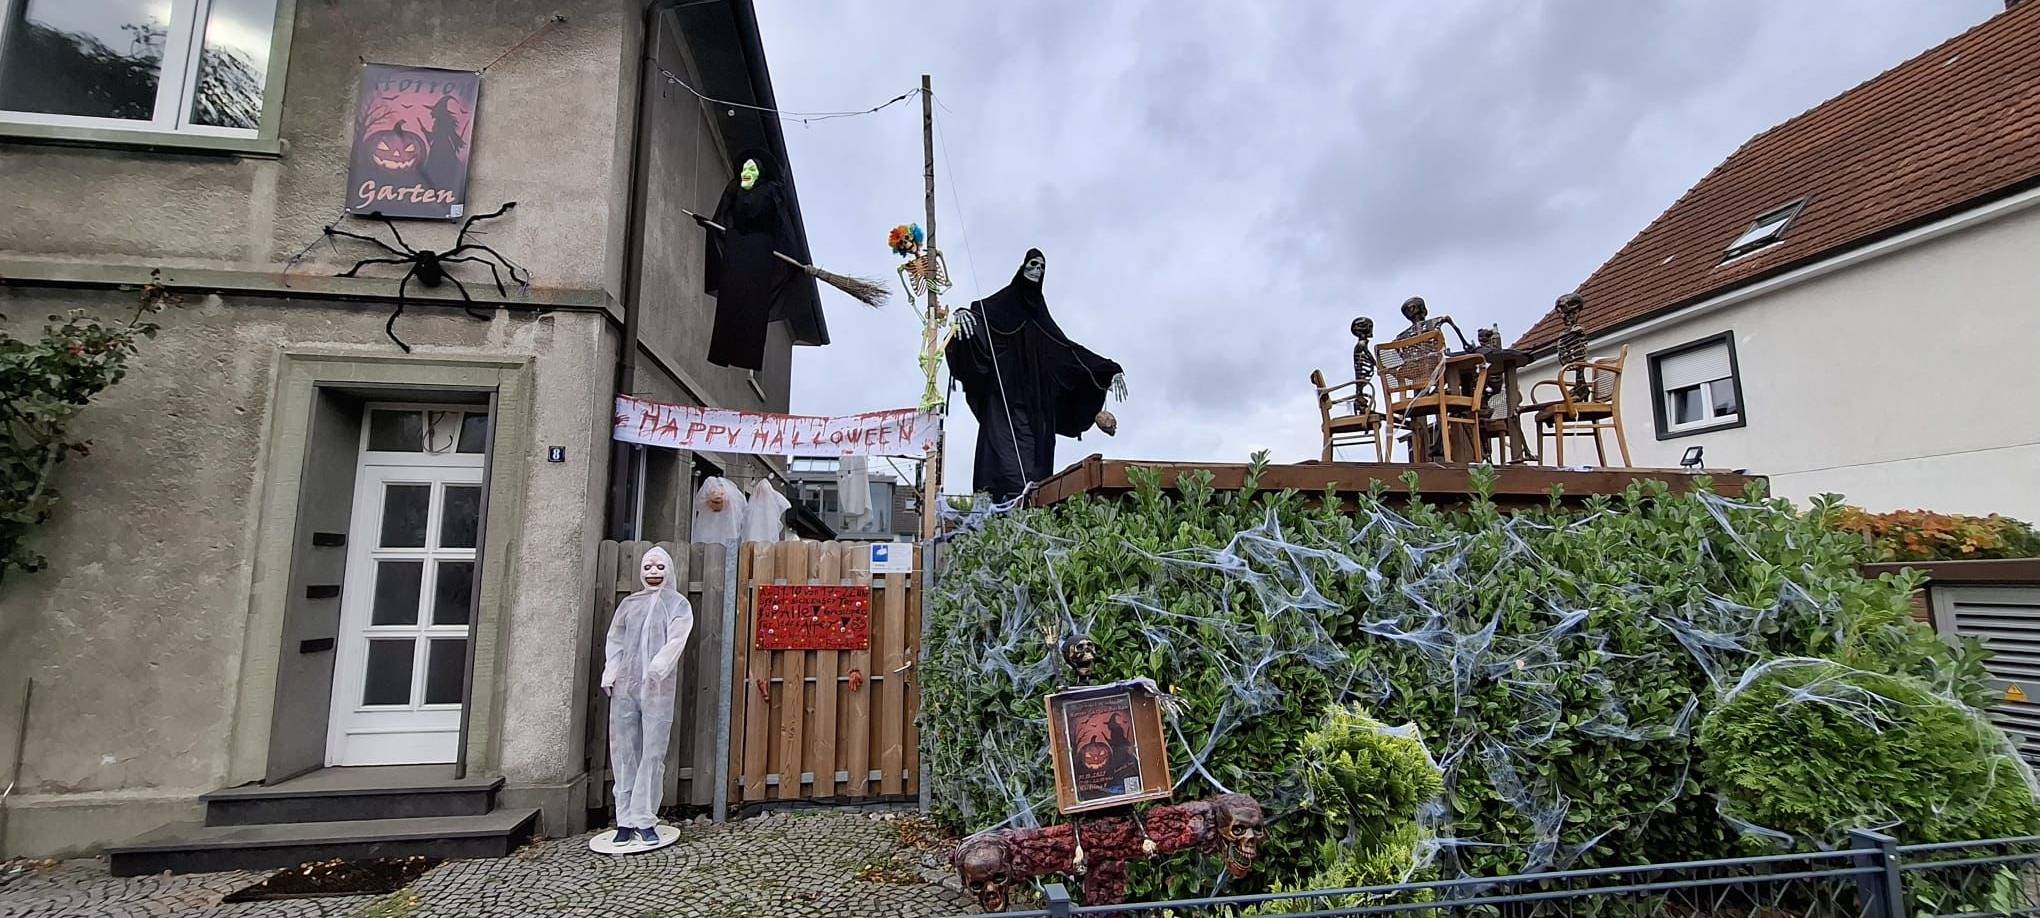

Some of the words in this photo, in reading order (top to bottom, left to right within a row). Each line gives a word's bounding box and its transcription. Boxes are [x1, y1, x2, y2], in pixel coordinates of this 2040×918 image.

[356, 180, 456, 209] Garten
[639, 404, 742, 447] HAPPY
[750, 417, 912, 452] HALLOWEEN
[552, 448, 561, 460] 8
